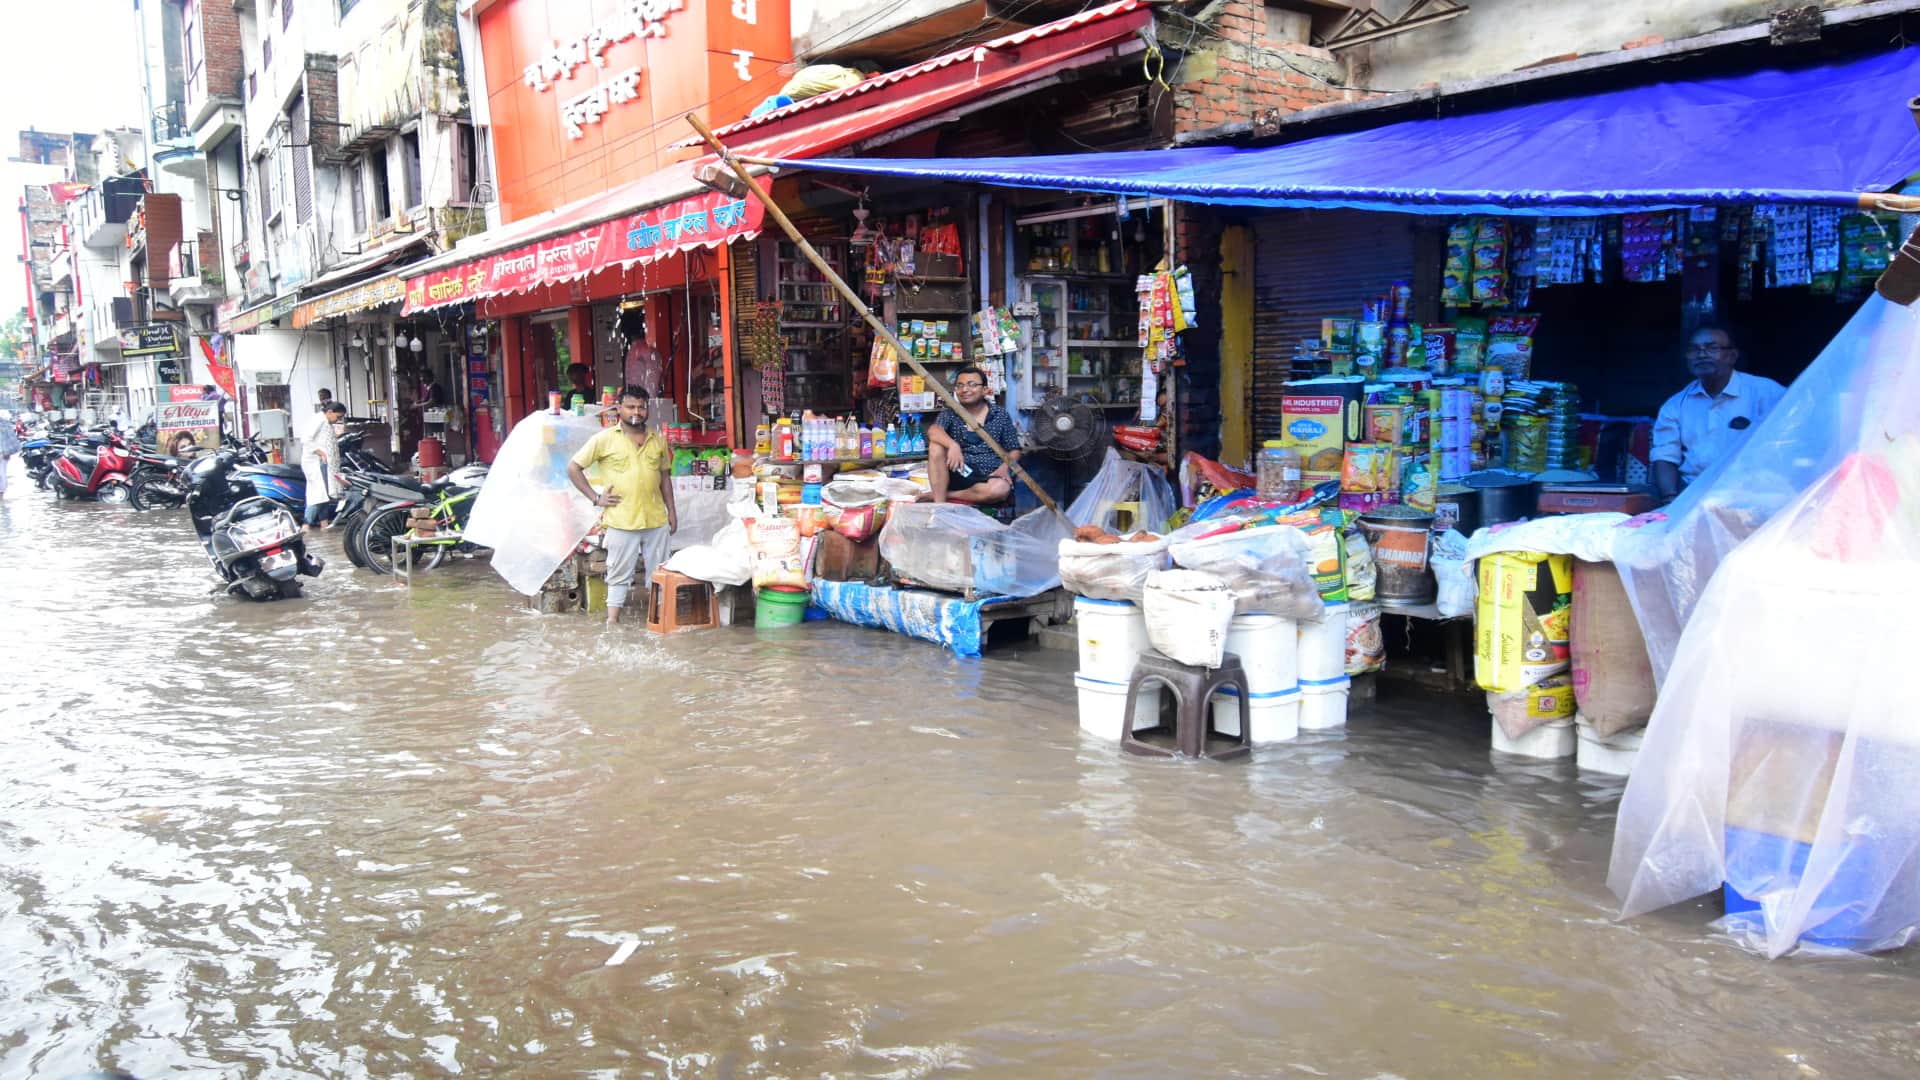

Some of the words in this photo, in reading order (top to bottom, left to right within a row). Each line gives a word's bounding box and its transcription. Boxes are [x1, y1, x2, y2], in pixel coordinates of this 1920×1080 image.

[1293, 399, 1339, 407] INDUSTRIES
[163, 404, 211, 419] Nitya
[161, 420, 185, 428] BEAUTY
[187, 418, 216, 427] PARLOUR
